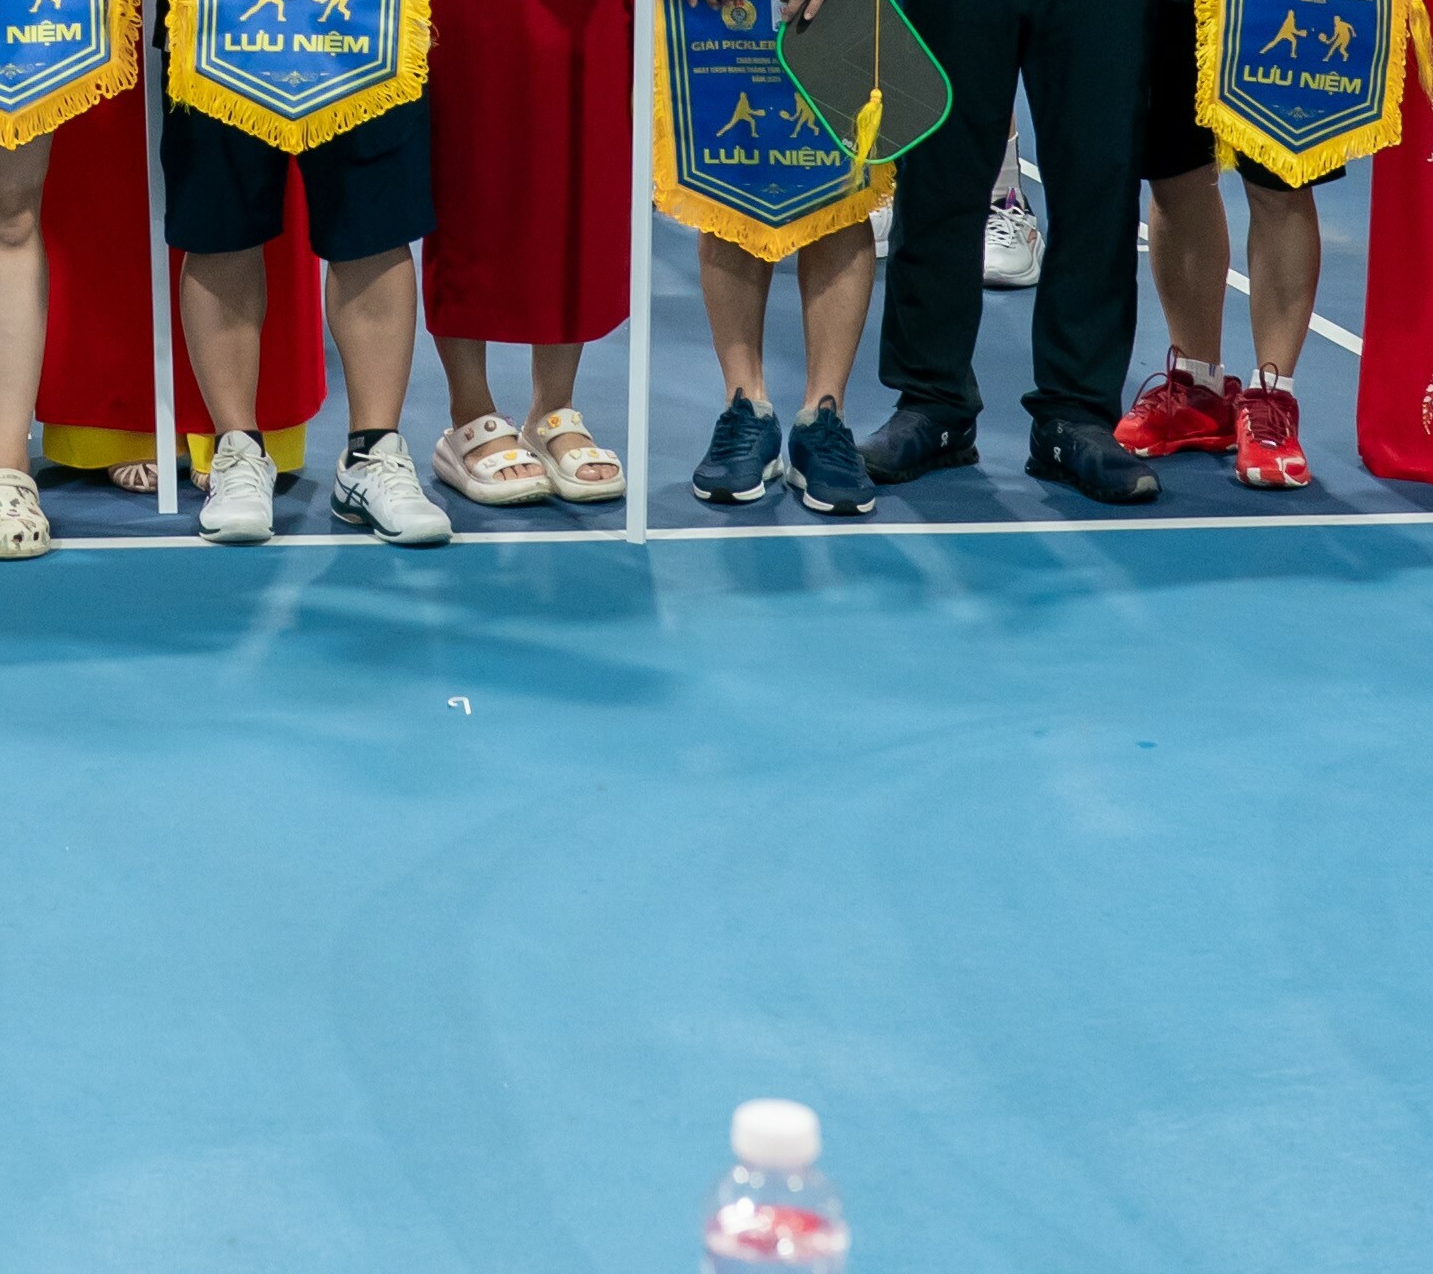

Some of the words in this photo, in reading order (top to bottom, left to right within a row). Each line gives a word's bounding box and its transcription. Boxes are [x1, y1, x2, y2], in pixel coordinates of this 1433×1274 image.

[7, 19, 82, 46] NIỆM
[224, 29, 284, 51] LƯU
[293, 30, 369, 56] NIỆM
[691, 38, 719, 51] GIẢI
[1243, 65, 1293, 86] LƯU
[1300, 71, 1362, 95] NIỆM
[704, 145, 760, 164] LƯU
[768, 146, 841, 170] NIỆM
